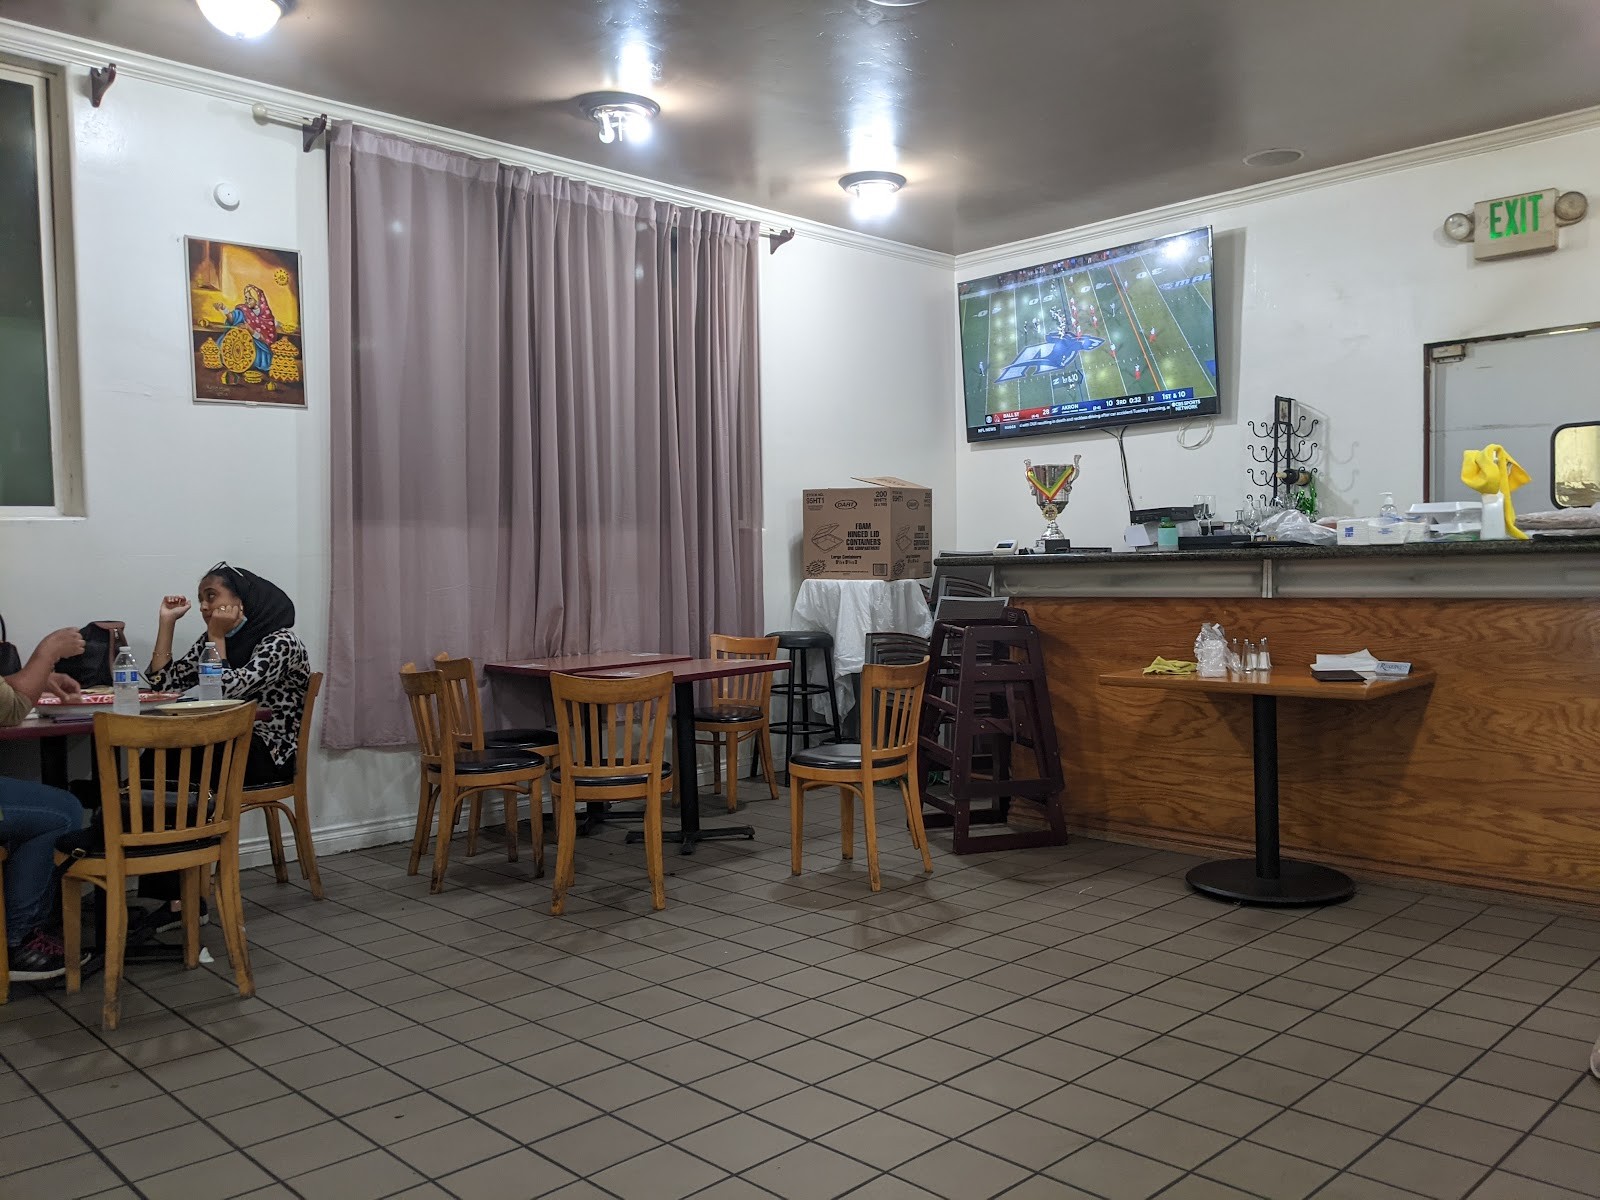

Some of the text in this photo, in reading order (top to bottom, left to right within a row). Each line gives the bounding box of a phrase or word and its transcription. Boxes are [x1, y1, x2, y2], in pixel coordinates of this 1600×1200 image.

[1489, 193, 1543, 239] EXIT
[855, 522, 871, 530] FOAM
[847, 530, 880, 538] HINGED LID
[845, 538, 881, 546] CONTAINERS
